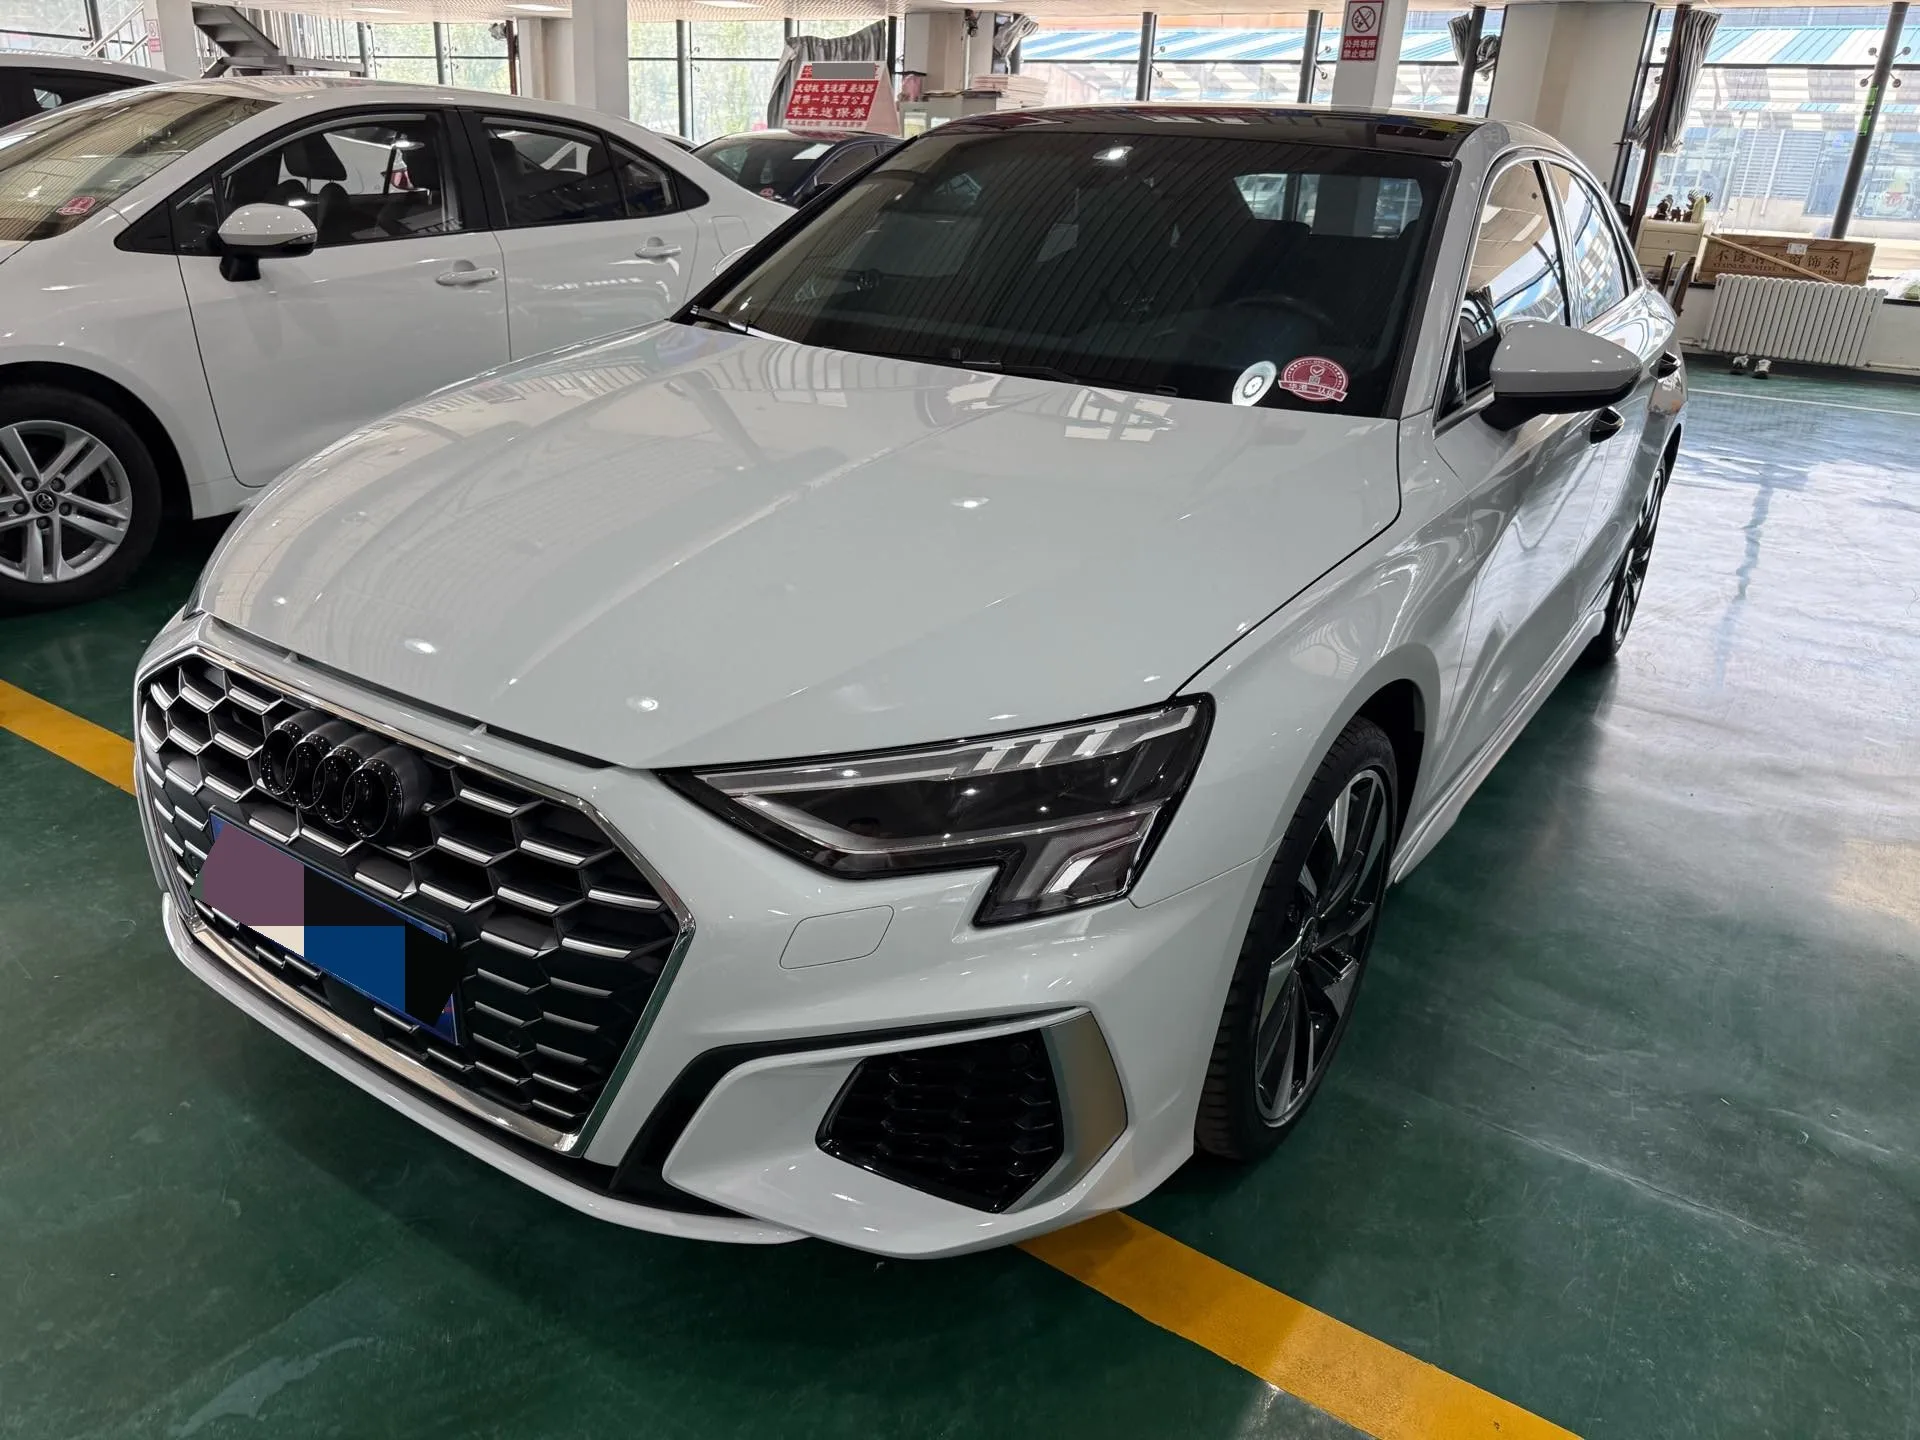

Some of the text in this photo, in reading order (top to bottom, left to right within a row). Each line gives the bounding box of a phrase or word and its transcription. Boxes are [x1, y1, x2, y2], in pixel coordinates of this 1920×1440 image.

[787, 107, 866, 118] 车车送保养
